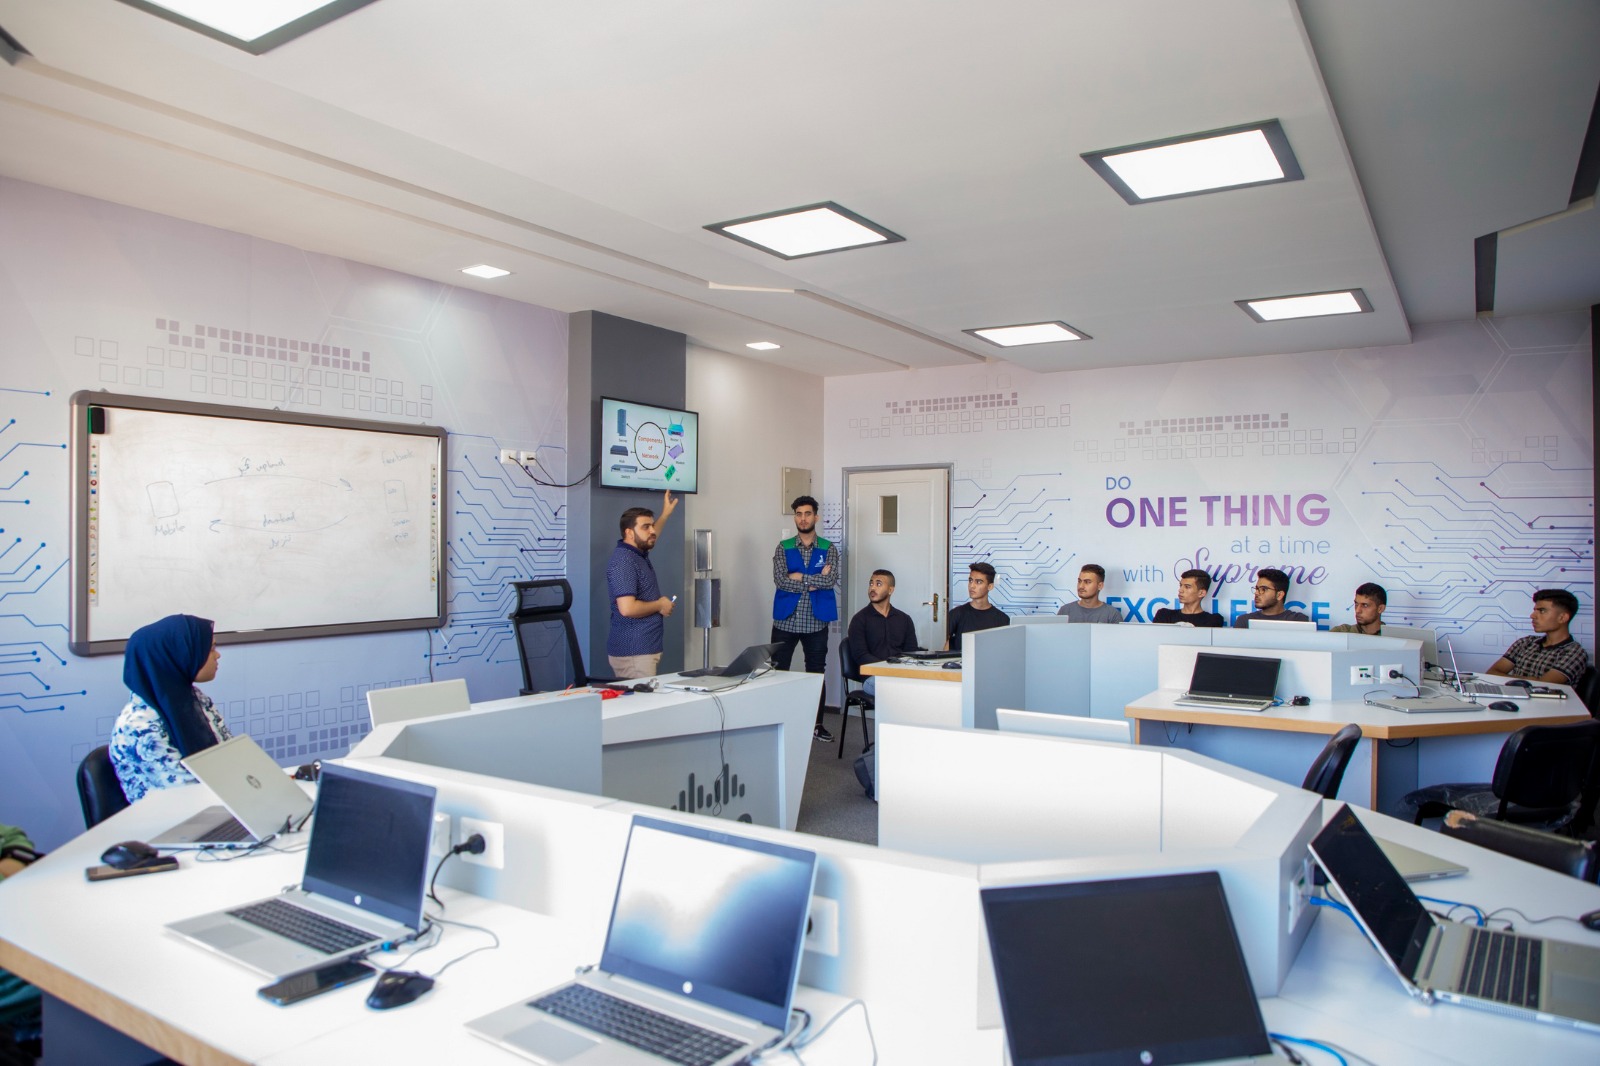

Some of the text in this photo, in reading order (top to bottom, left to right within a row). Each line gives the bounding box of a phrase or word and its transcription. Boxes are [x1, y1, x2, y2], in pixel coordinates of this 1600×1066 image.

[1106, 476, 1131, 490] DO
[1106, 493, 1330, 528] ONE THING
[1231, 536, 1330, 554] at a time
[1123, 547, 1329, 598] with Suprme
[1106, 597, 1330, 631] XCLEE
